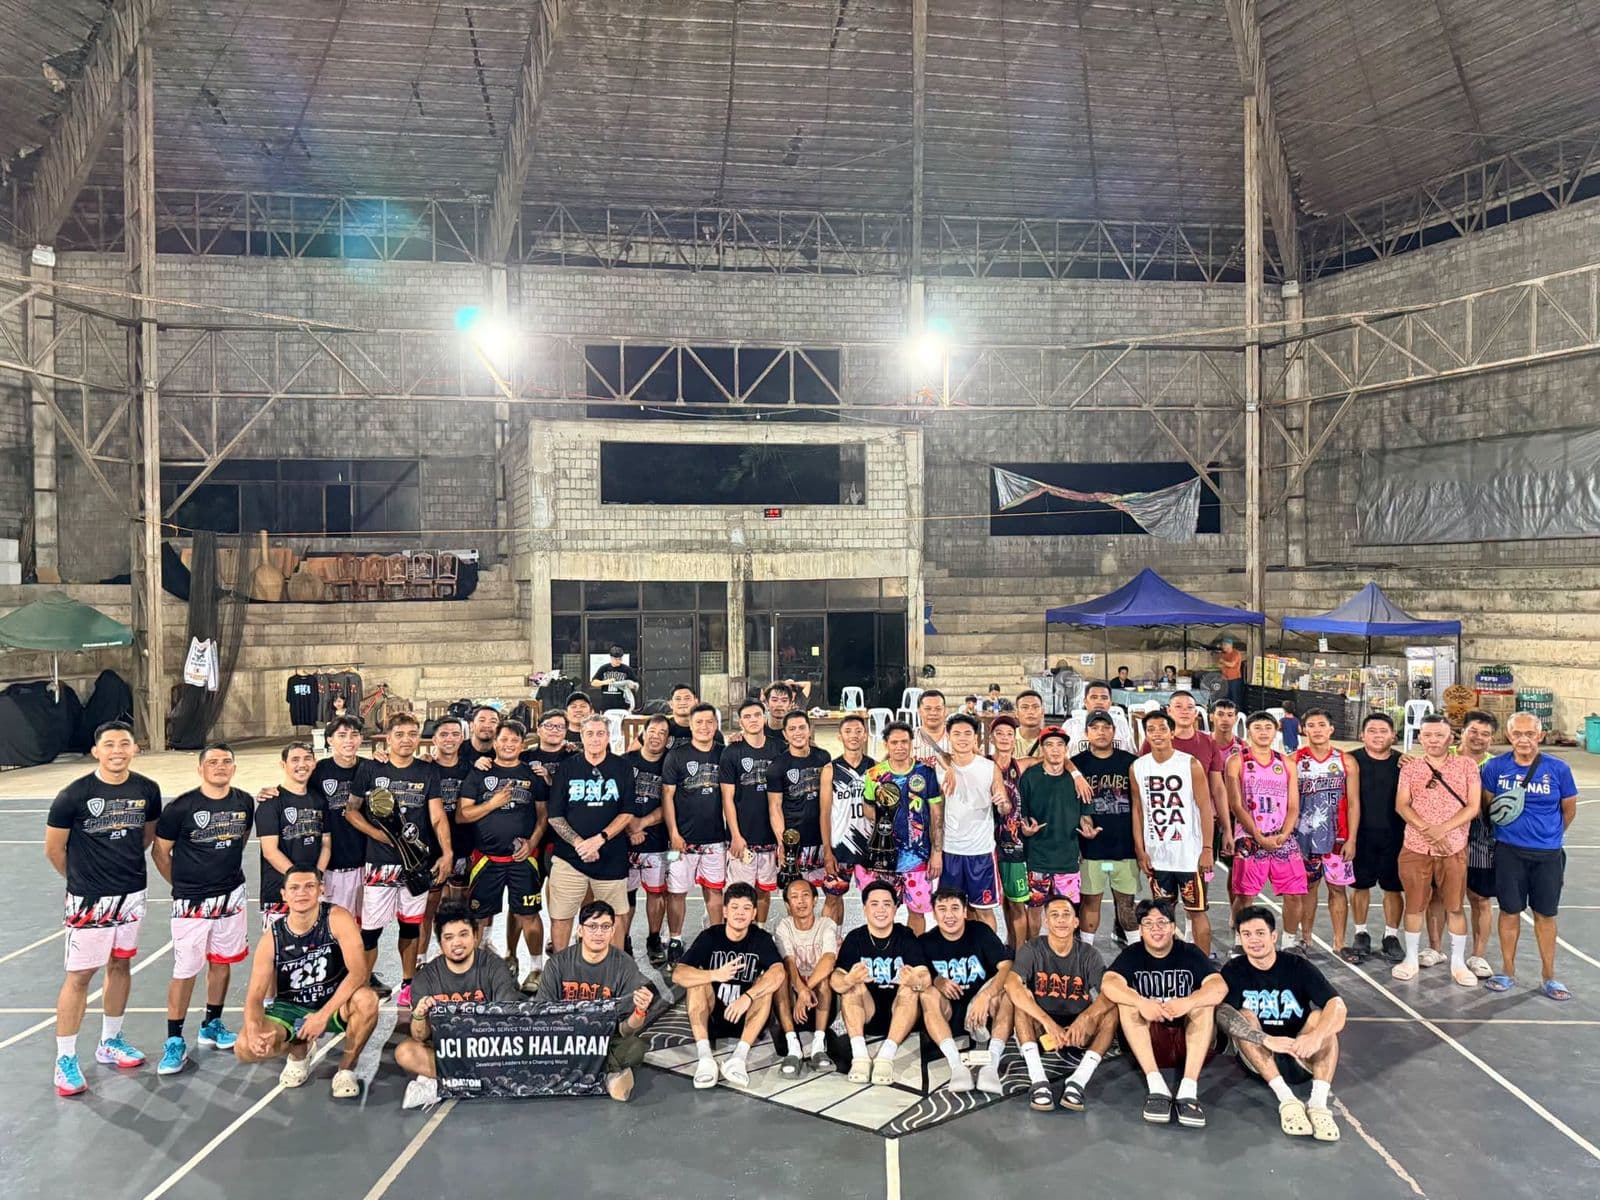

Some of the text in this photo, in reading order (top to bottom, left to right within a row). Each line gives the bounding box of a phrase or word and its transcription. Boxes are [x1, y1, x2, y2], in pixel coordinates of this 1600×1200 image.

[1149, 774, 1183, 792] BO
[1498, 778, 1551, 795] FILINAS
[1150, 792, 1184, 808] RA
[1327, 792, 1338, 806] 15
[850, 803, 864, 819] 10
[1152, 809, 1186, 825] CA
[1154, 825, 1168, 841] Y
[436, 1035, 611, 1059] JCI ROXAS HALARAN
